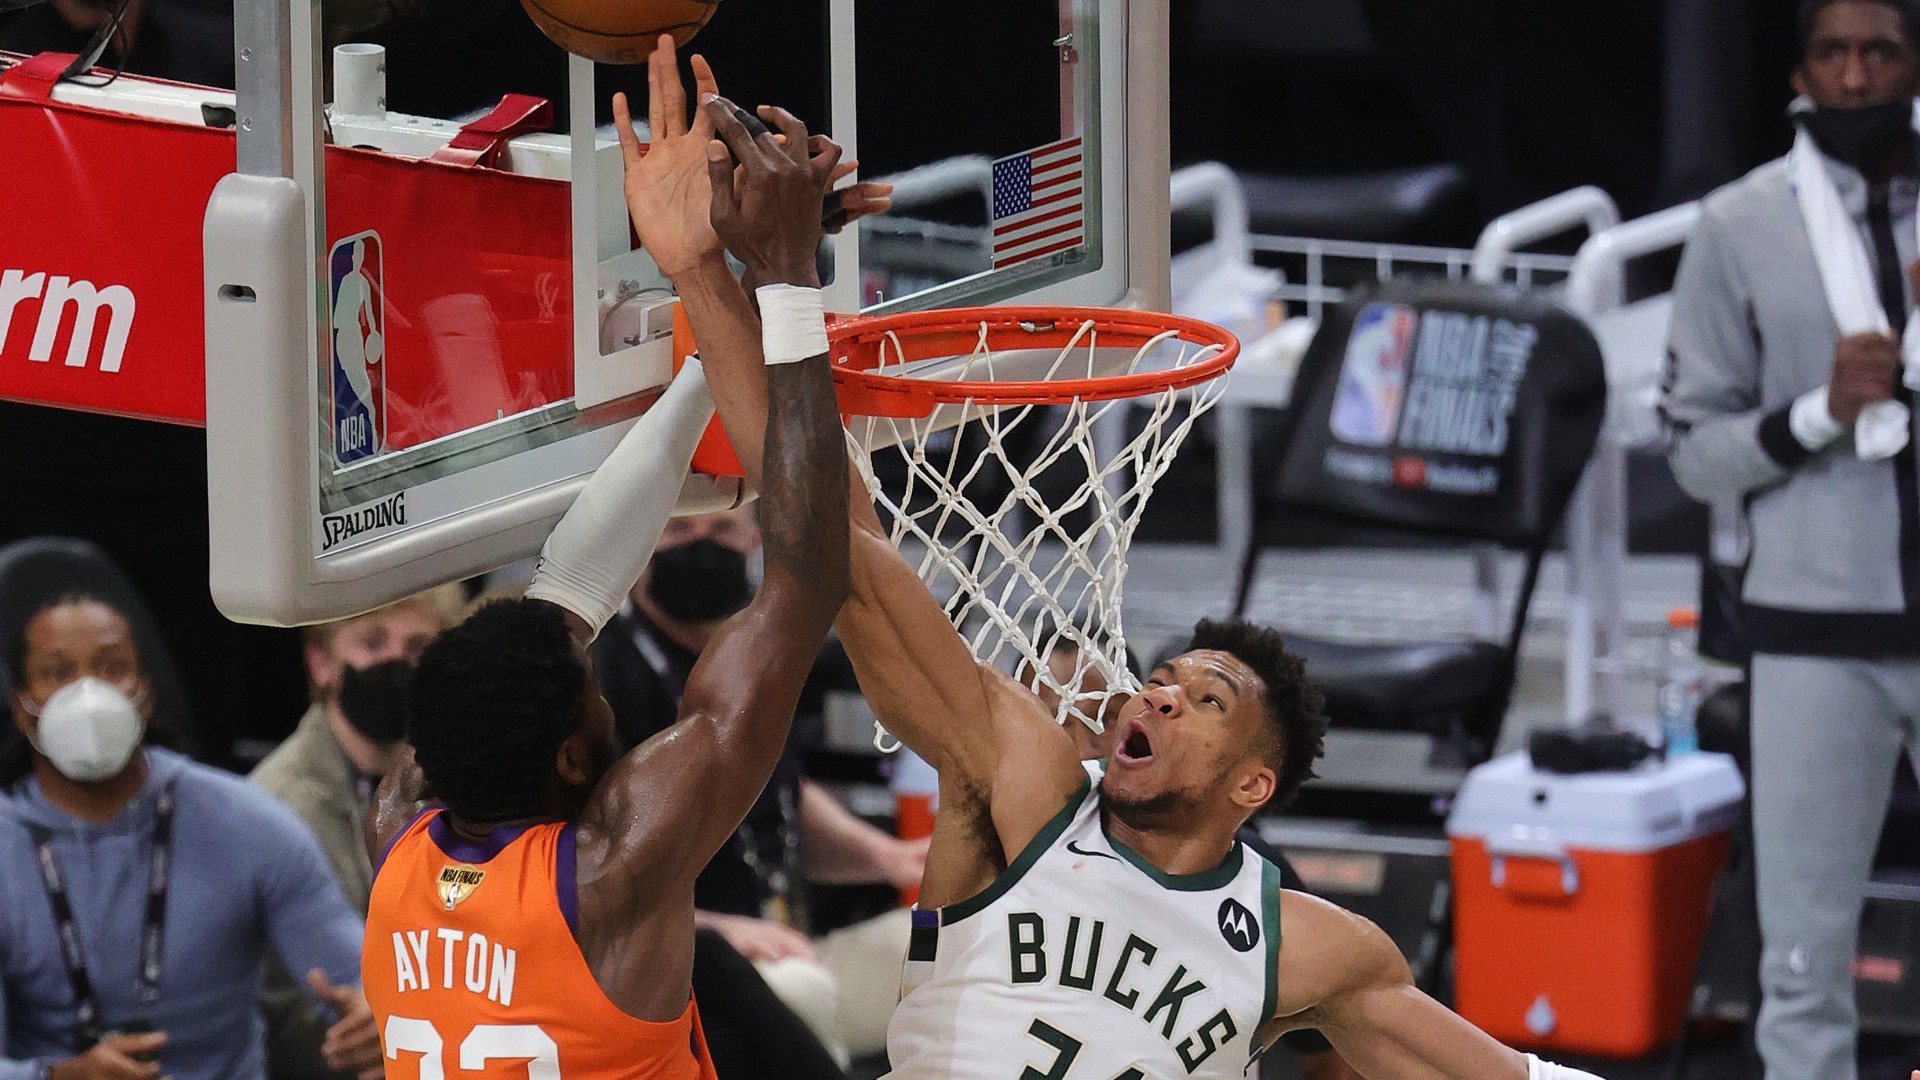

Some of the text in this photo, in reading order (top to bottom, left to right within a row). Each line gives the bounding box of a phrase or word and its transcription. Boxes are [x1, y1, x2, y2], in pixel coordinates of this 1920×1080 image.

[340, 412, 367, 454] NBA
[322, 490, 406, 551] SPALDING
[440, 868, 484, 885] NBA FINALS
[391, 927, 517, 1008] AYTON
[1006, 910, 1239, 1077] BUCKS
